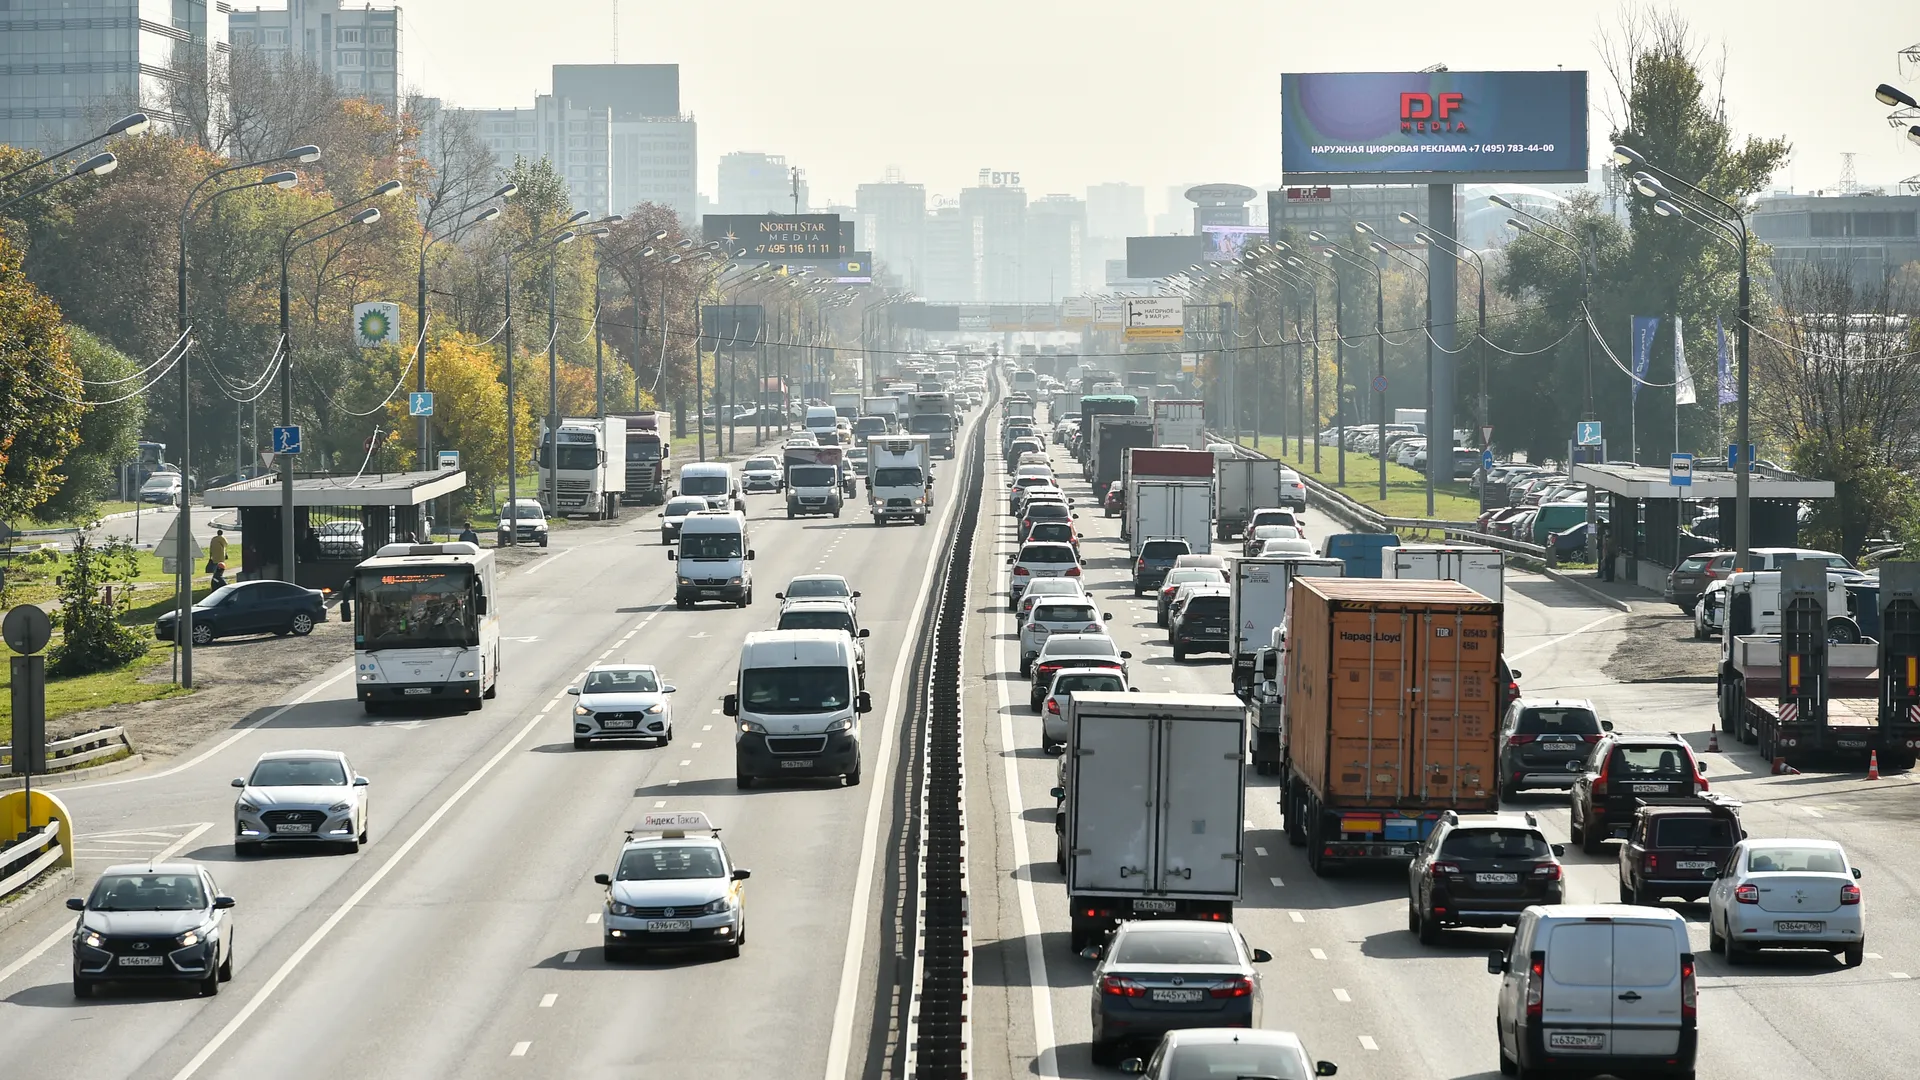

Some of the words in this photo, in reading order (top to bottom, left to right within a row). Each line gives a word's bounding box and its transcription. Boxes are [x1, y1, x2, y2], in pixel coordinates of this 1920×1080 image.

[1400, 92, 1463, 119] DF
[1400, 121, 1466, 132] MEDIA
[1311, 145, 1364, 154] НАРУЖНАЯ
[1366, 145, 1418, 155] ЦИФРОВАЯ
[1420, 144, 1467, 154] РЕКЛАМА
[1468, 145, 1480, 153] +7
[1481, 144, 1506, 155] (495)
[1507, 144, 1554, 153] 783-44-00
[991, 171, 1020, 185] ВТБ
[769, 233, 820, 241] MEDIA
[754, 244, 766, 254] +7
[768, 244, 786, 254] 495
[789, 244, 804, 254] 116
[807, 244, 816, 253] 11
[820, 244, 829, 253] 11
[1340, 631, 1401, 644] Hapag-Lloyd
[645, 816, 675, 826] Яндекс
[677, 814, 700, 825] Такси
